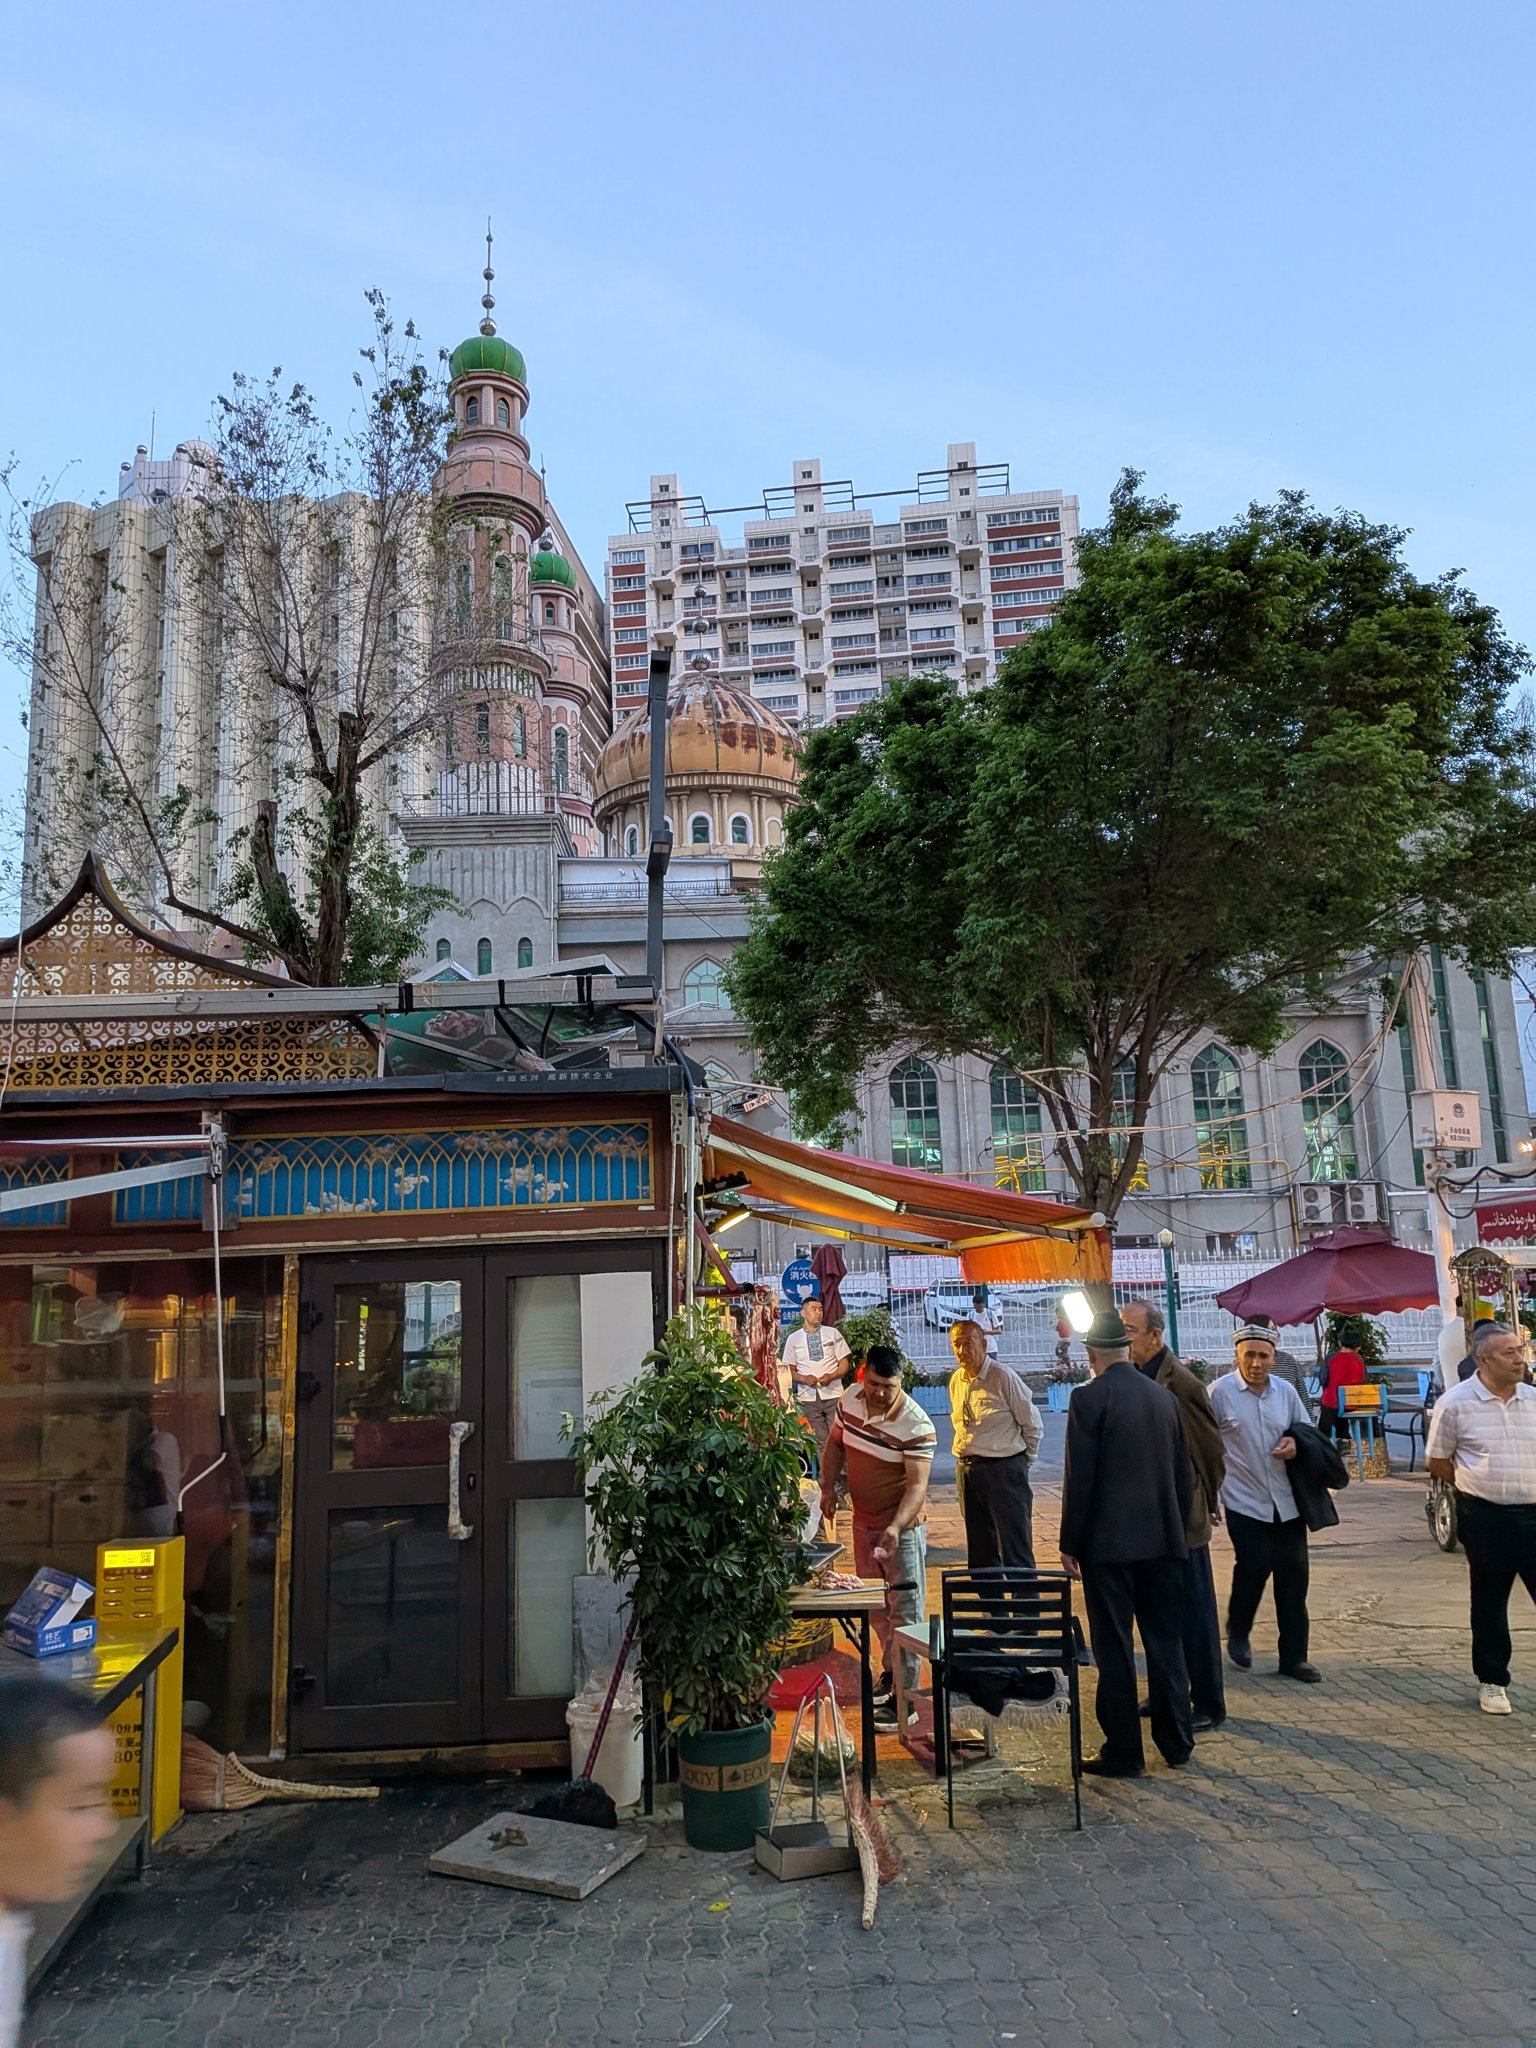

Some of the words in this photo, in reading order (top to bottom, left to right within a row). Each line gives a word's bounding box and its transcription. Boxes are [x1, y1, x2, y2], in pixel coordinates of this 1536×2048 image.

[547, 1071, 614, 1081] 高新技术企业
